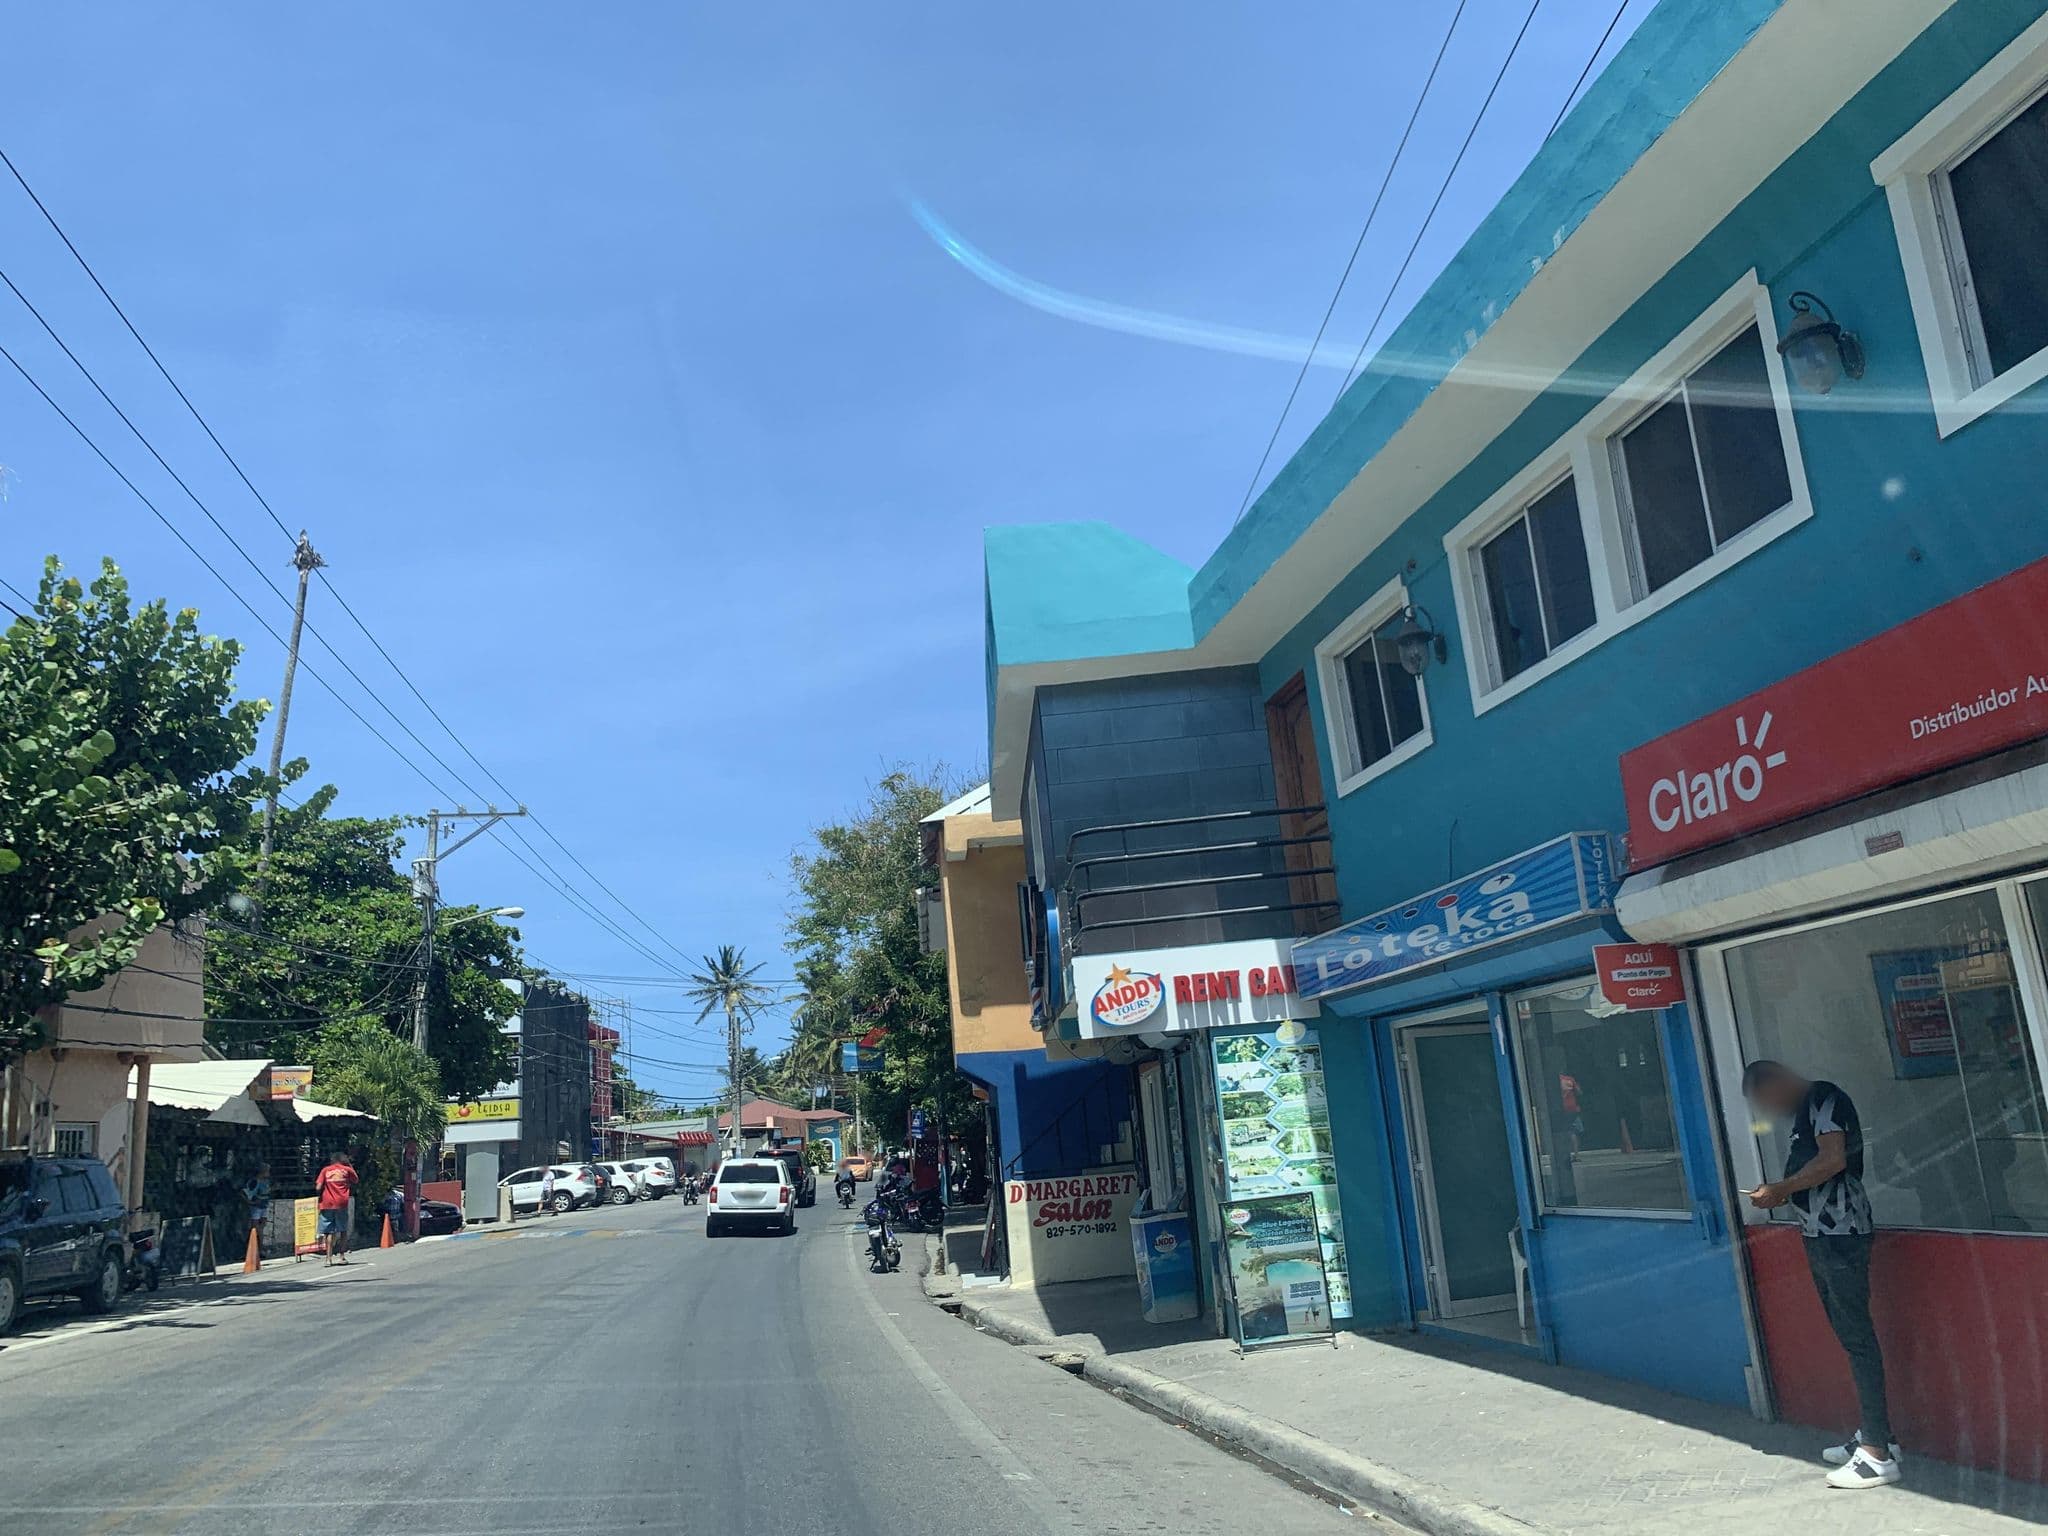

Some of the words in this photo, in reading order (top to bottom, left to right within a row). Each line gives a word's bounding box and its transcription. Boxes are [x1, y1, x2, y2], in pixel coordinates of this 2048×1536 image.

[1910, 686, 2019, 740] Distribuidor
[1649, 754, 1763, 832] Claro
[1316, 891, 1531, 981] Loteka
[1423, 941, 1453, 957] te
[1461, 912, 1535, 944] toca
[1095, 973, 1161, 1016] ANDDY
[1173, 969, 1241, 1004] RENT
[1627, 986, 1657, 997] Claro
[1114, 998, 1150, 1017] TOURS
[1033, 1198, 1112, 1227] Salon
[1046, 1222, 1118, 1239] 829-570-1892
